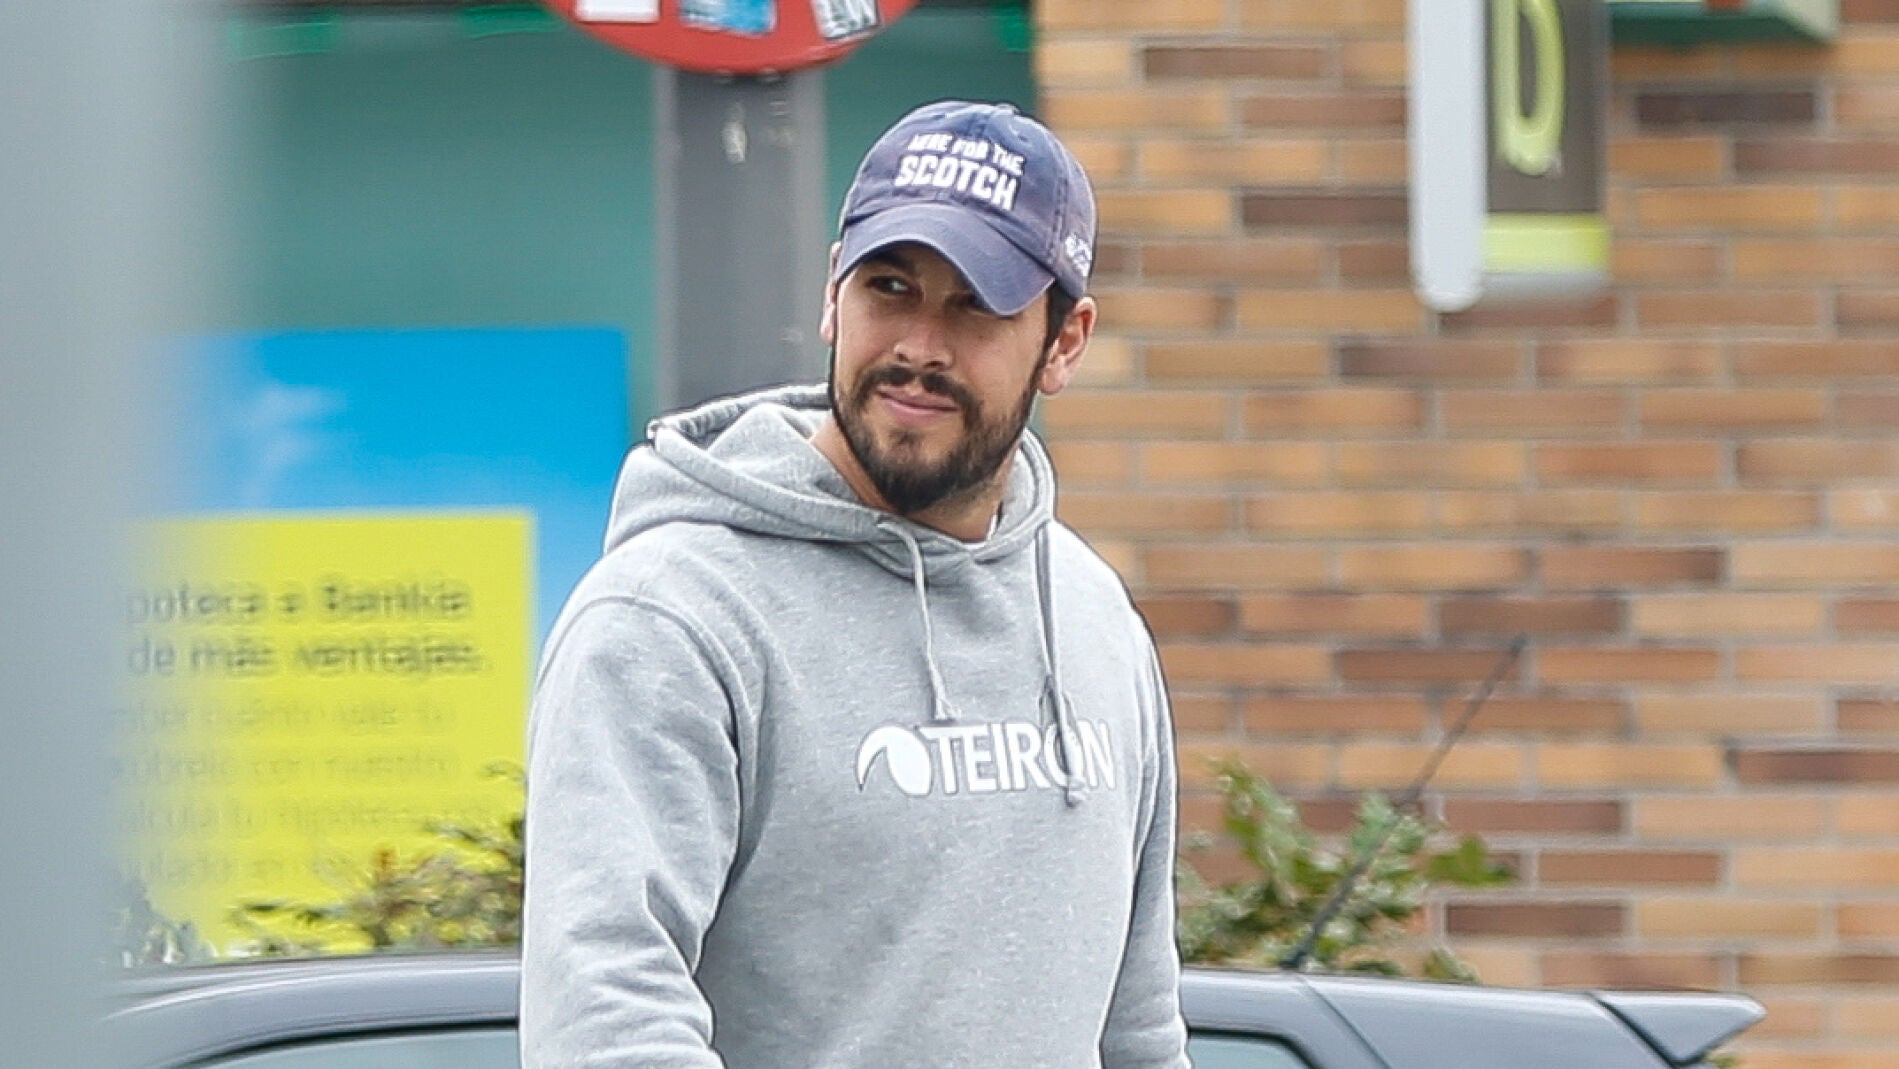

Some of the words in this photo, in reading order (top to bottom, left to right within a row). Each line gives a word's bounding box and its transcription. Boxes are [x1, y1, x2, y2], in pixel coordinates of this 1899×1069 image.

[993, 142, 1026, 176] THE
[893, 153, 1020, 212] SCOTCH
[126, 636, 176, 676] de
